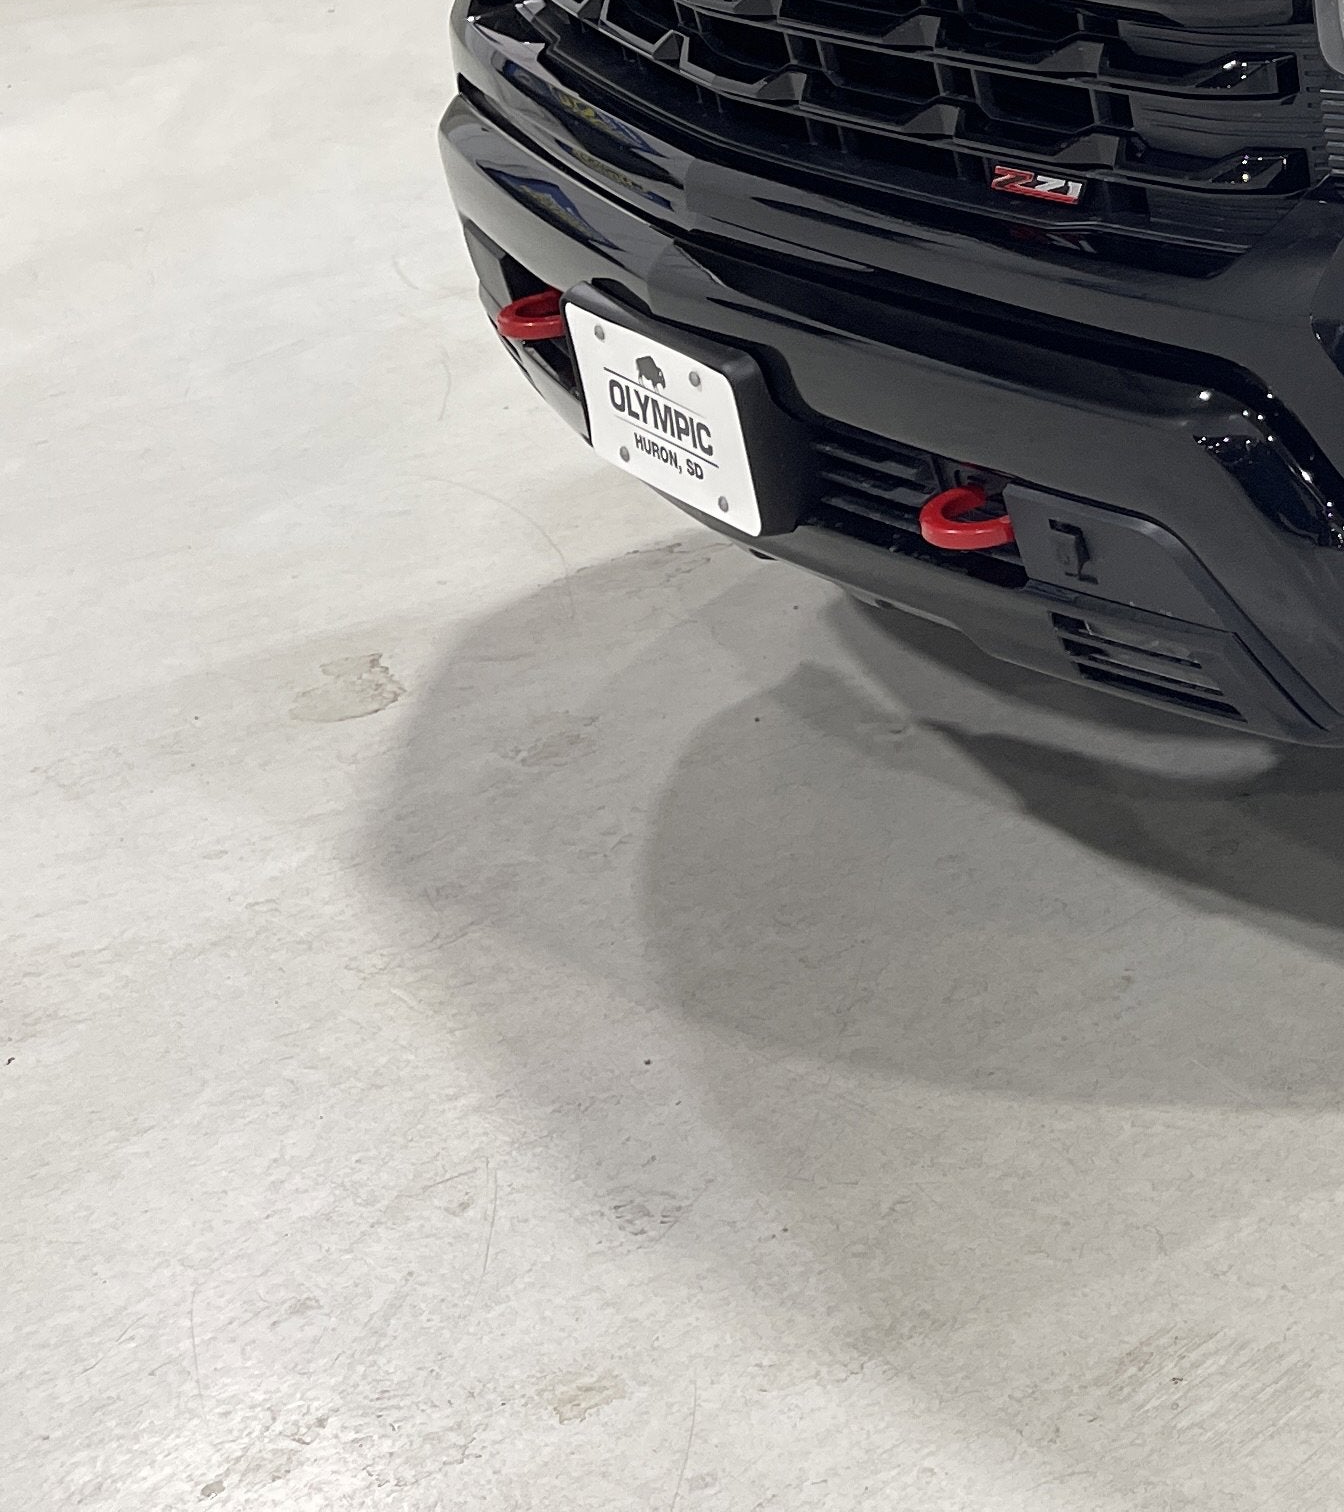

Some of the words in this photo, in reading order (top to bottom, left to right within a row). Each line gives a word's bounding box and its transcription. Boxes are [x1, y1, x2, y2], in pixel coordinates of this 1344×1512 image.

[991, 165, 1083, 205] Z71
[608, 378, 714, 457] OLYMPIC
[633, 431, 683, 474] HURON,
[686, 458, 704, 480] SD
